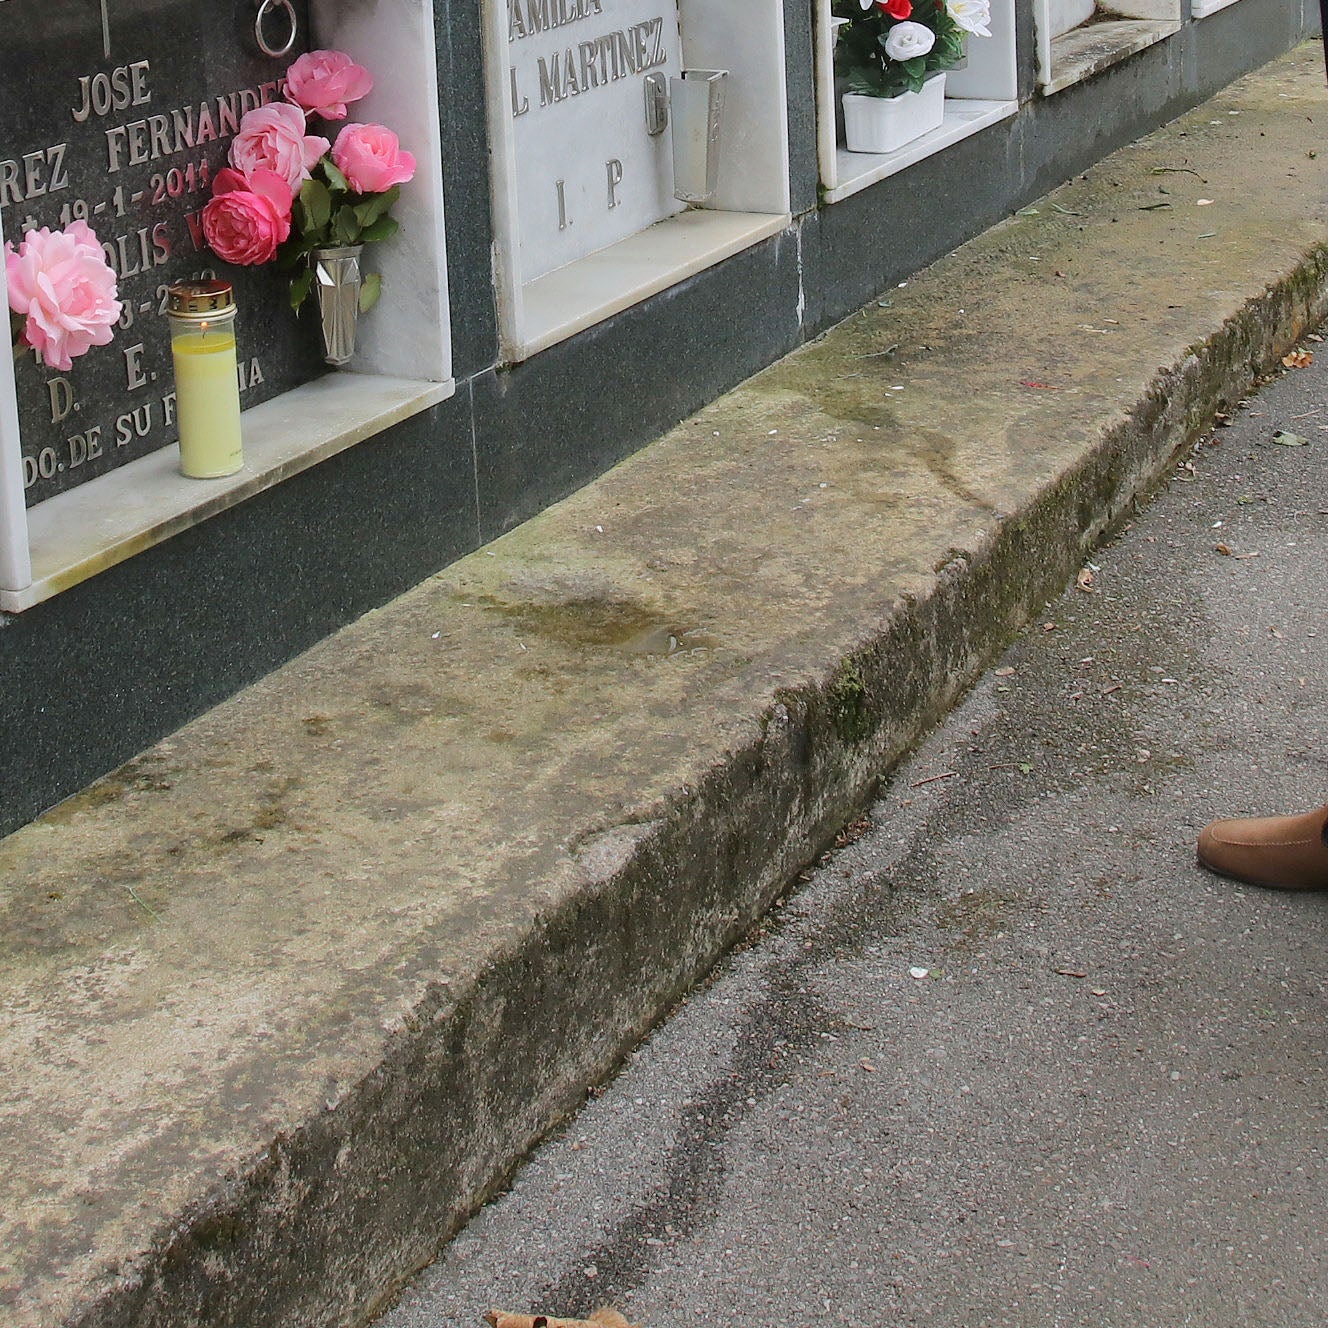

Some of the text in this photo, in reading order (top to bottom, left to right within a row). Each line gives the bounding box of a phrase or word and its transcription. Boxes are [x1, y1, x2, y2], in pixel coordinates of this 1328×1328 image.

[72, 59, 152, 122] JOSE
[510, 16, 668, 118] L MARTINEZ
[103, 221, 172, 280] OLIS
[47, 343, 157, 424] D. E.
[21, 446, 65, 489] DO.
[67, 426, 103, 469] DE
[116, 404, 152, 447] SU
